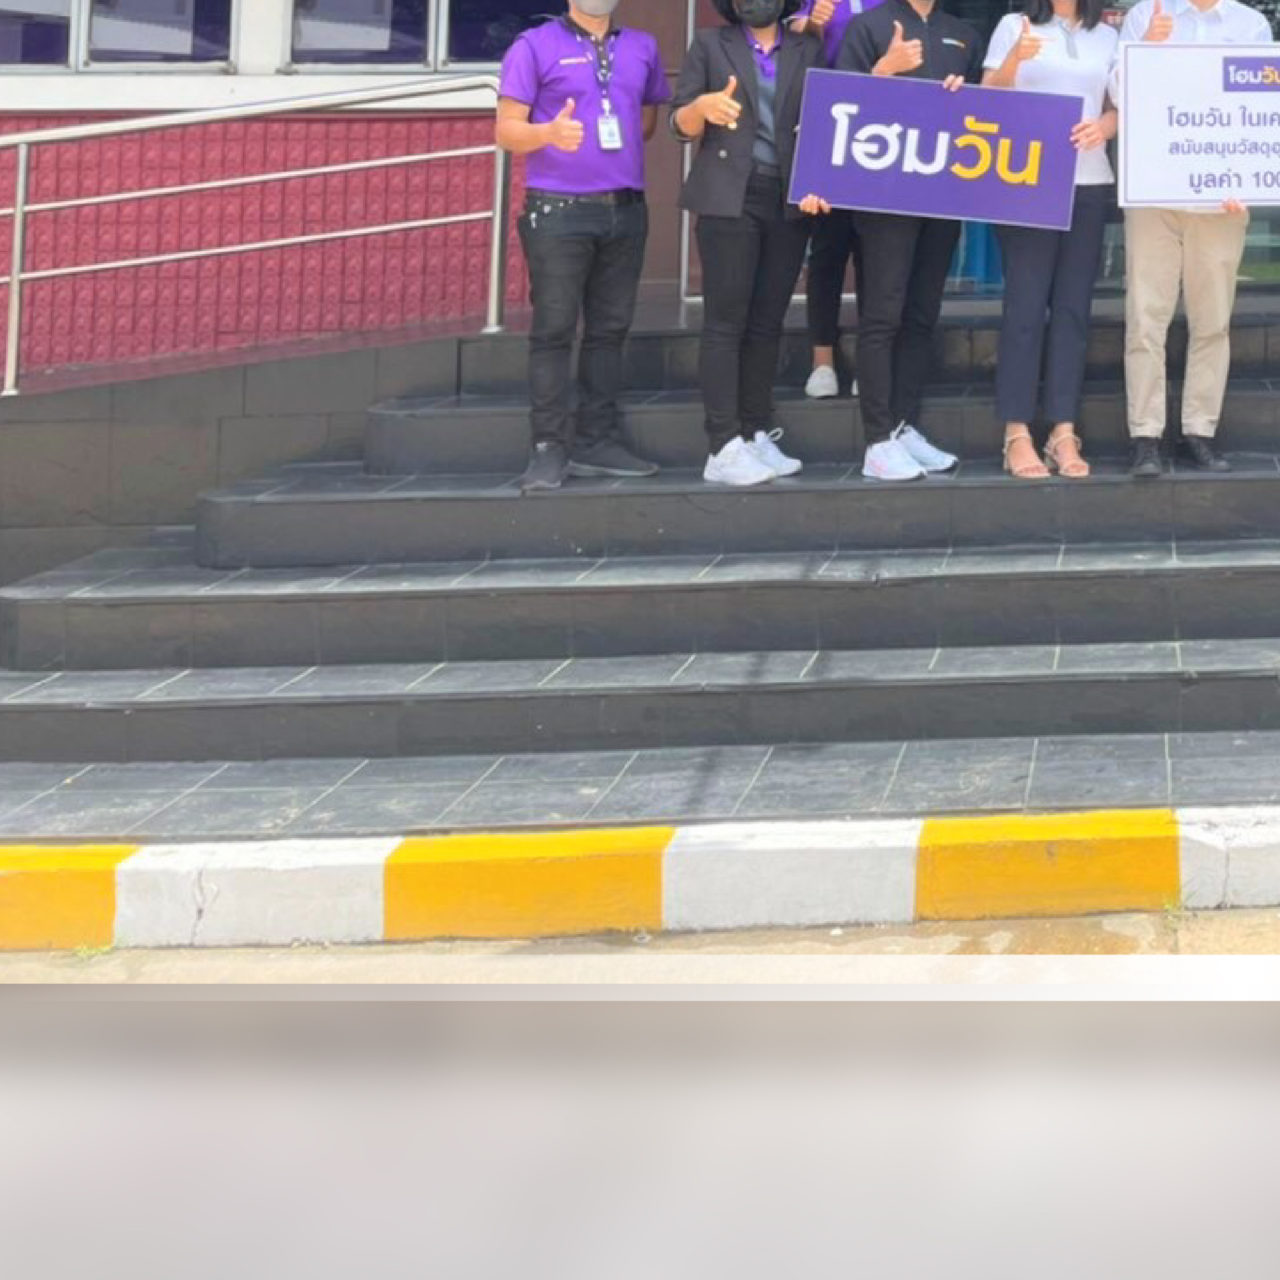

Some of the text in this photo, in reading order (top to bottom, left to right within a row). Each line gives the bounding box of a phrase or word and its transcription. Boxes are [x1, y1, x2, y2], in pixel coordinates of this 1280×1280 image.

[1167, 106, 1231, 128] โฮมวัน
[830, 102, 1043, 186] โฮมวัน
[1189, 168, 1243, 195] มูลค่า
